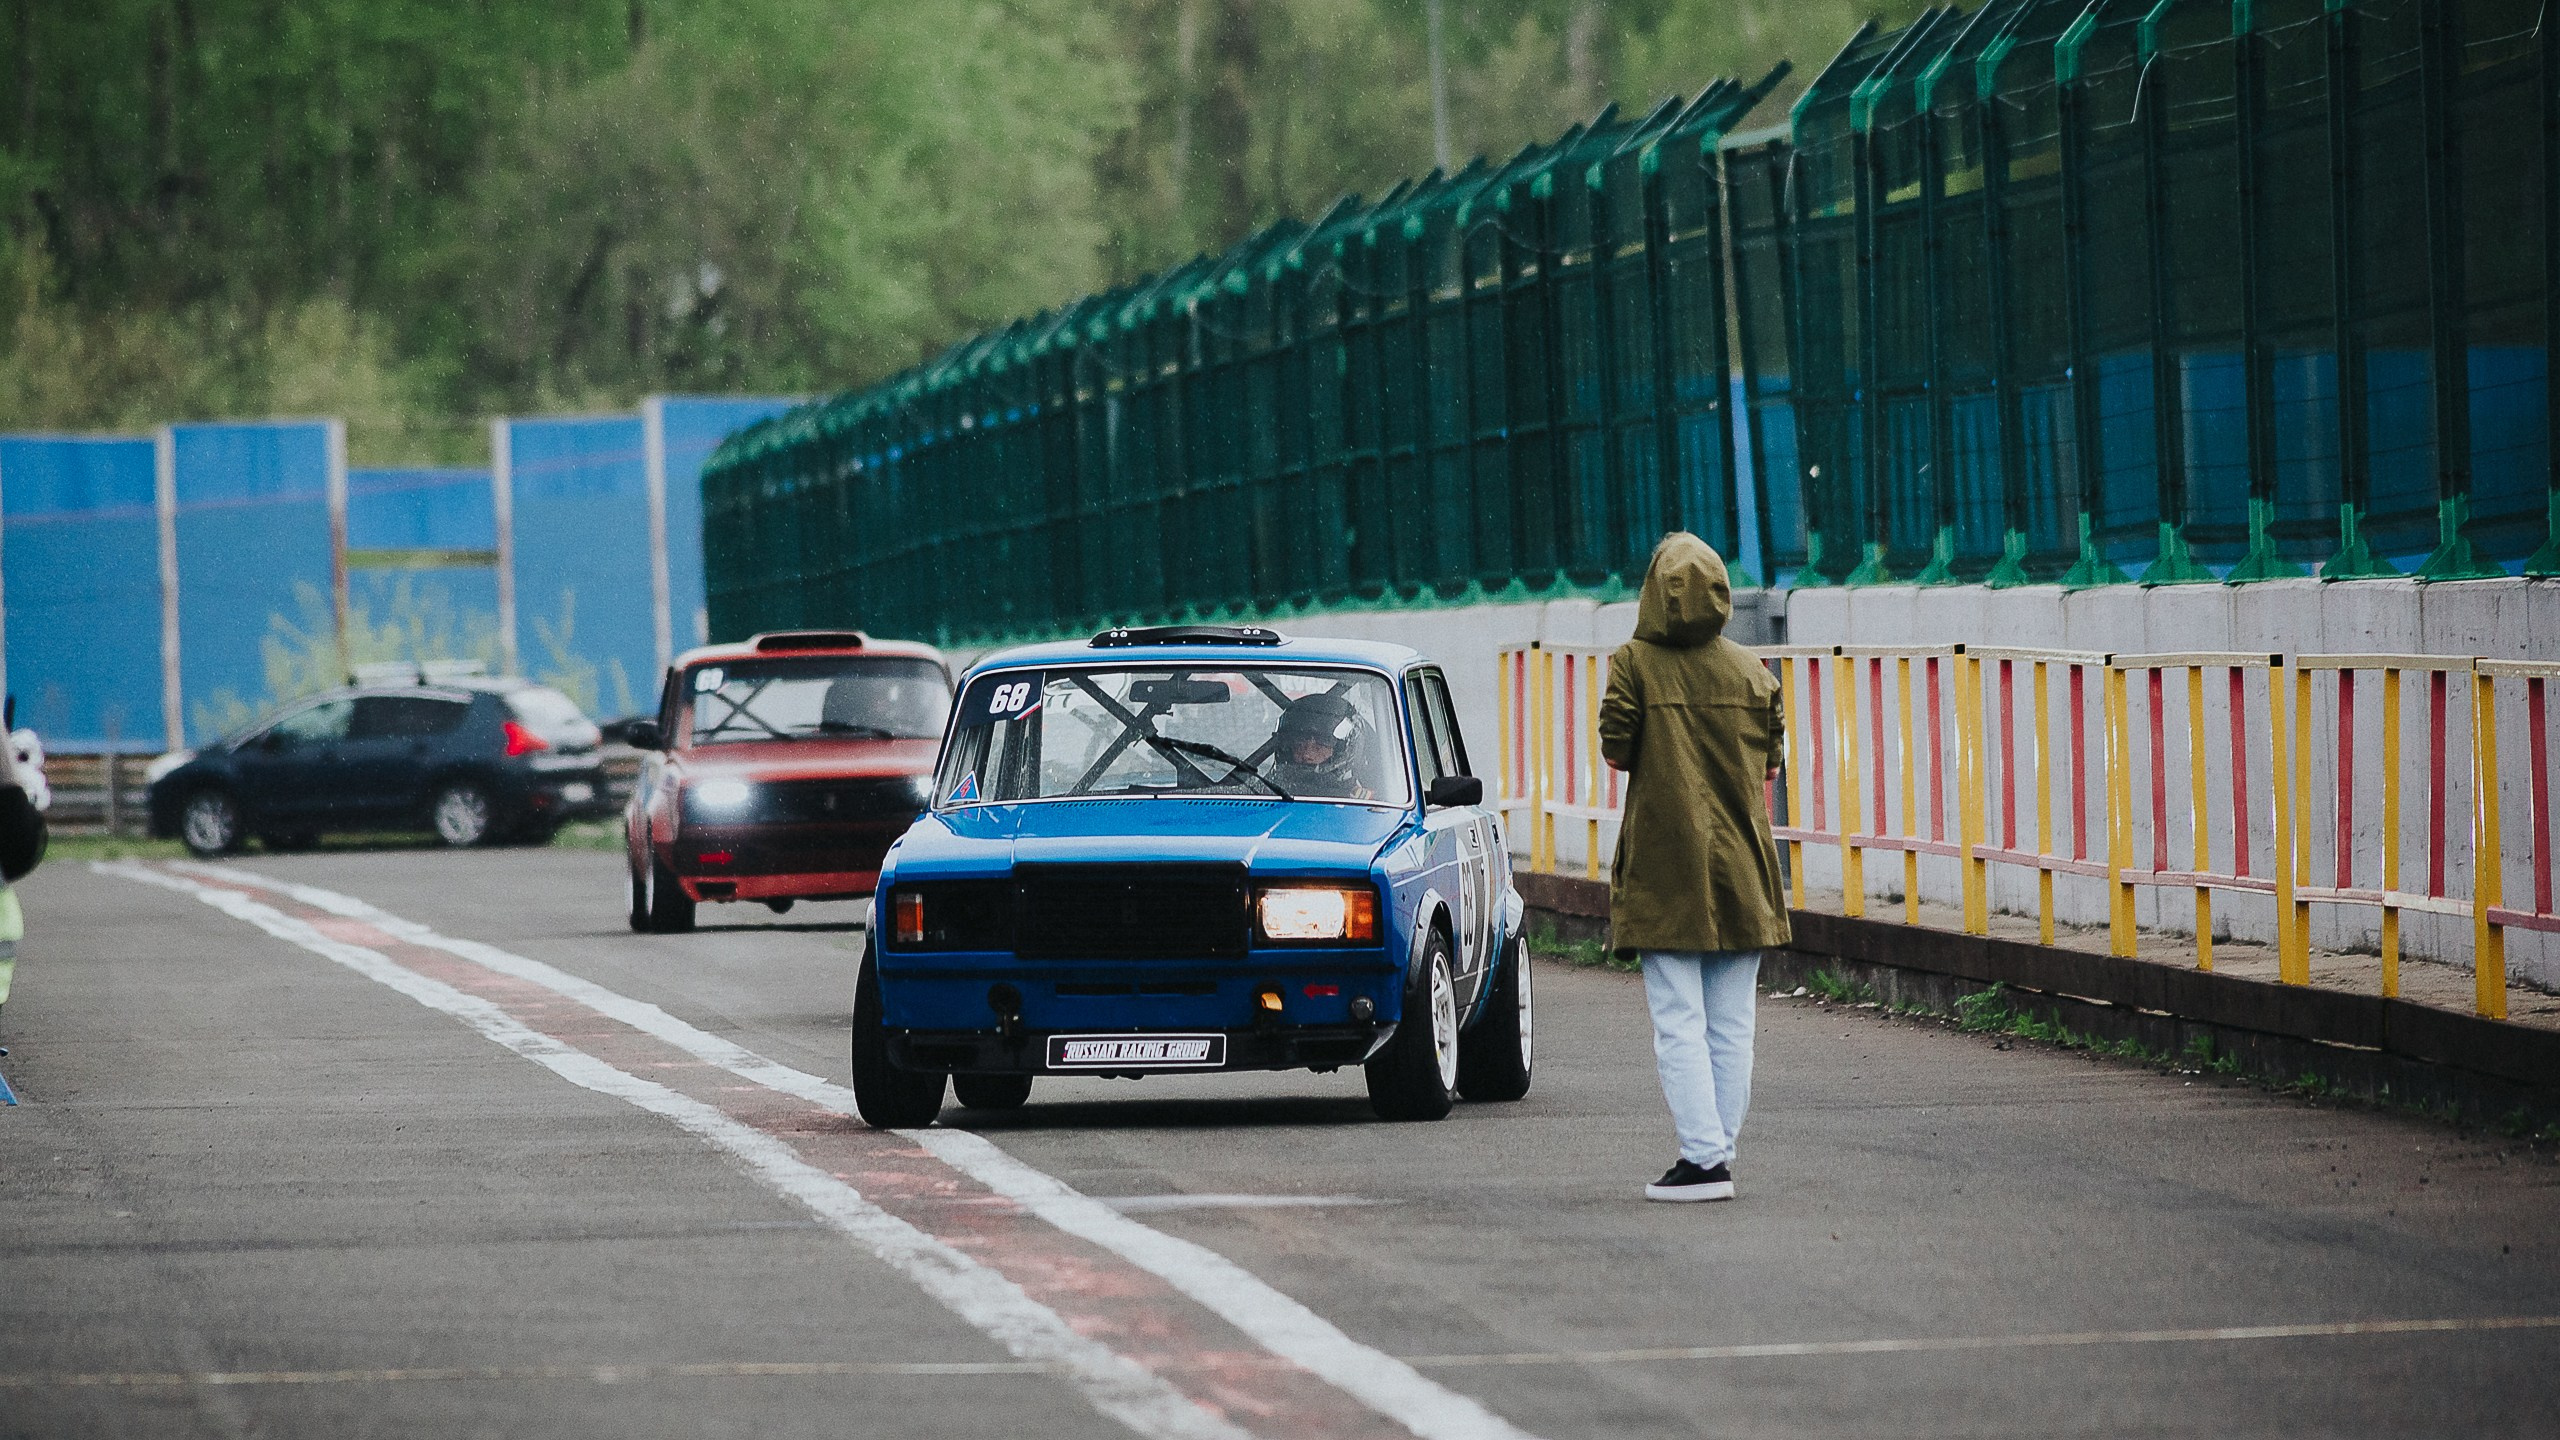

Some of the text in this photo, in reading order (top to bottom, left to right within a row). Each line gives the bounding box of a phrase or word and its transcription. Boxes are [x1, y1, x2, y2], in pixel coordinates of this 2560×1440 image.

[989, 682, 1031, 714] 68
[1067, 1041, 1206, 1059] RUSSIAN RACING GROUP
